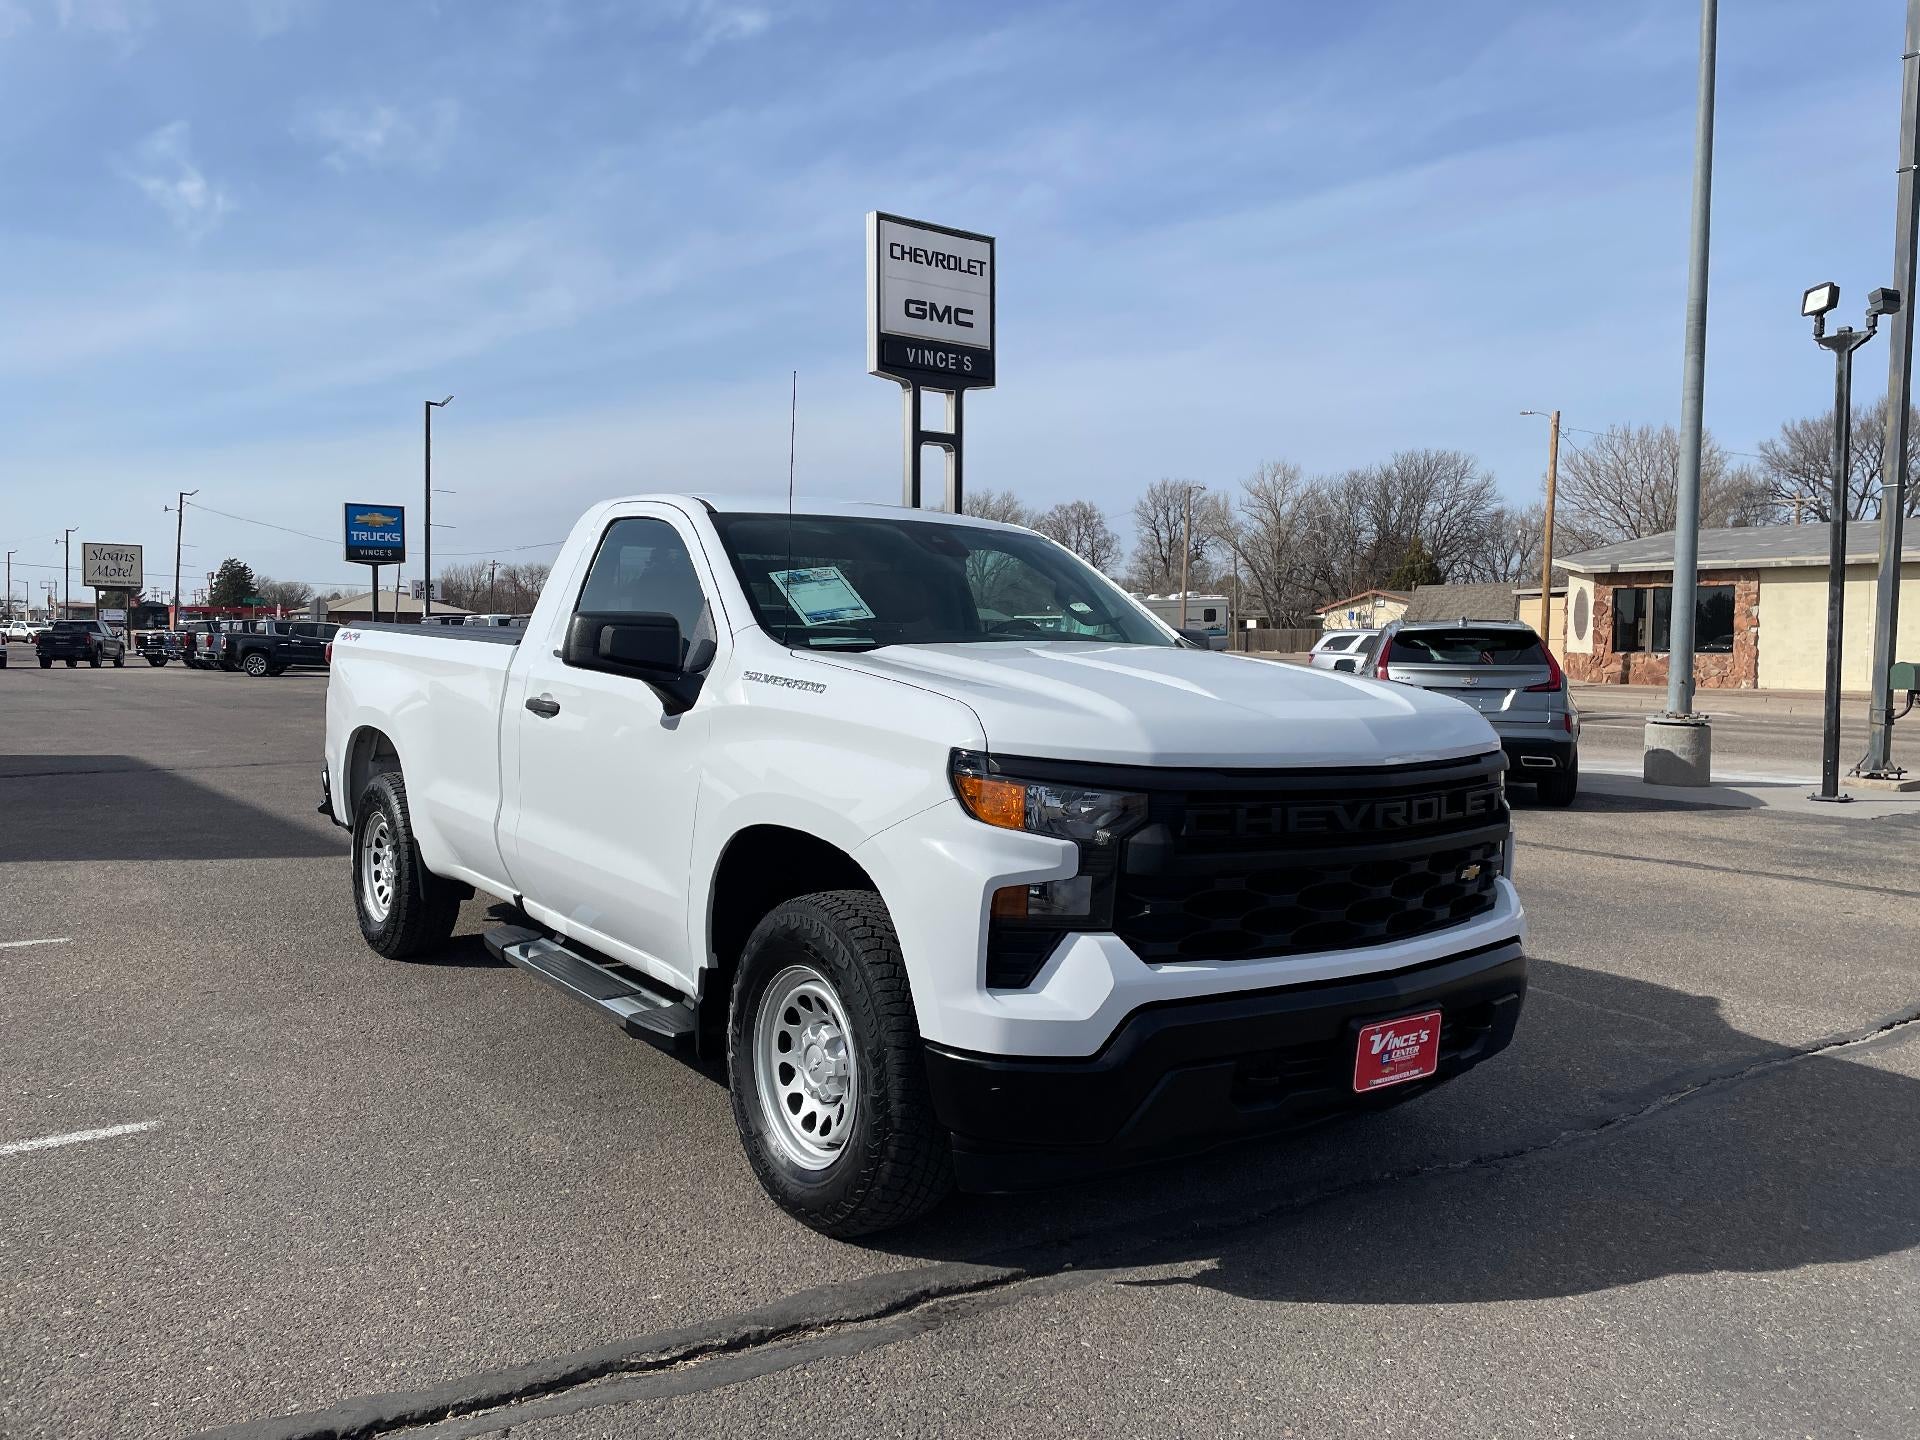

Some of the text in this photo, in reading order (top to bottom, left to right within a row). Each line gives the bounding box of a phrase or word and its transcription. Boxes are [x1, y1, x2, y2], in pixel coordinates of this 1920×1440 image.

[889, 242, 987, 277] CHEVROLET
[904, 298, 974, 328] GMC
[906, 347, 973, 371] VINCE'S
[350, 531, 401, 542] TRUCKS
[360, 549, 392, 557] VINCE'S
[92, 564, 133, 577] Motel
[741, 670, 827, 693] SILVERADO
